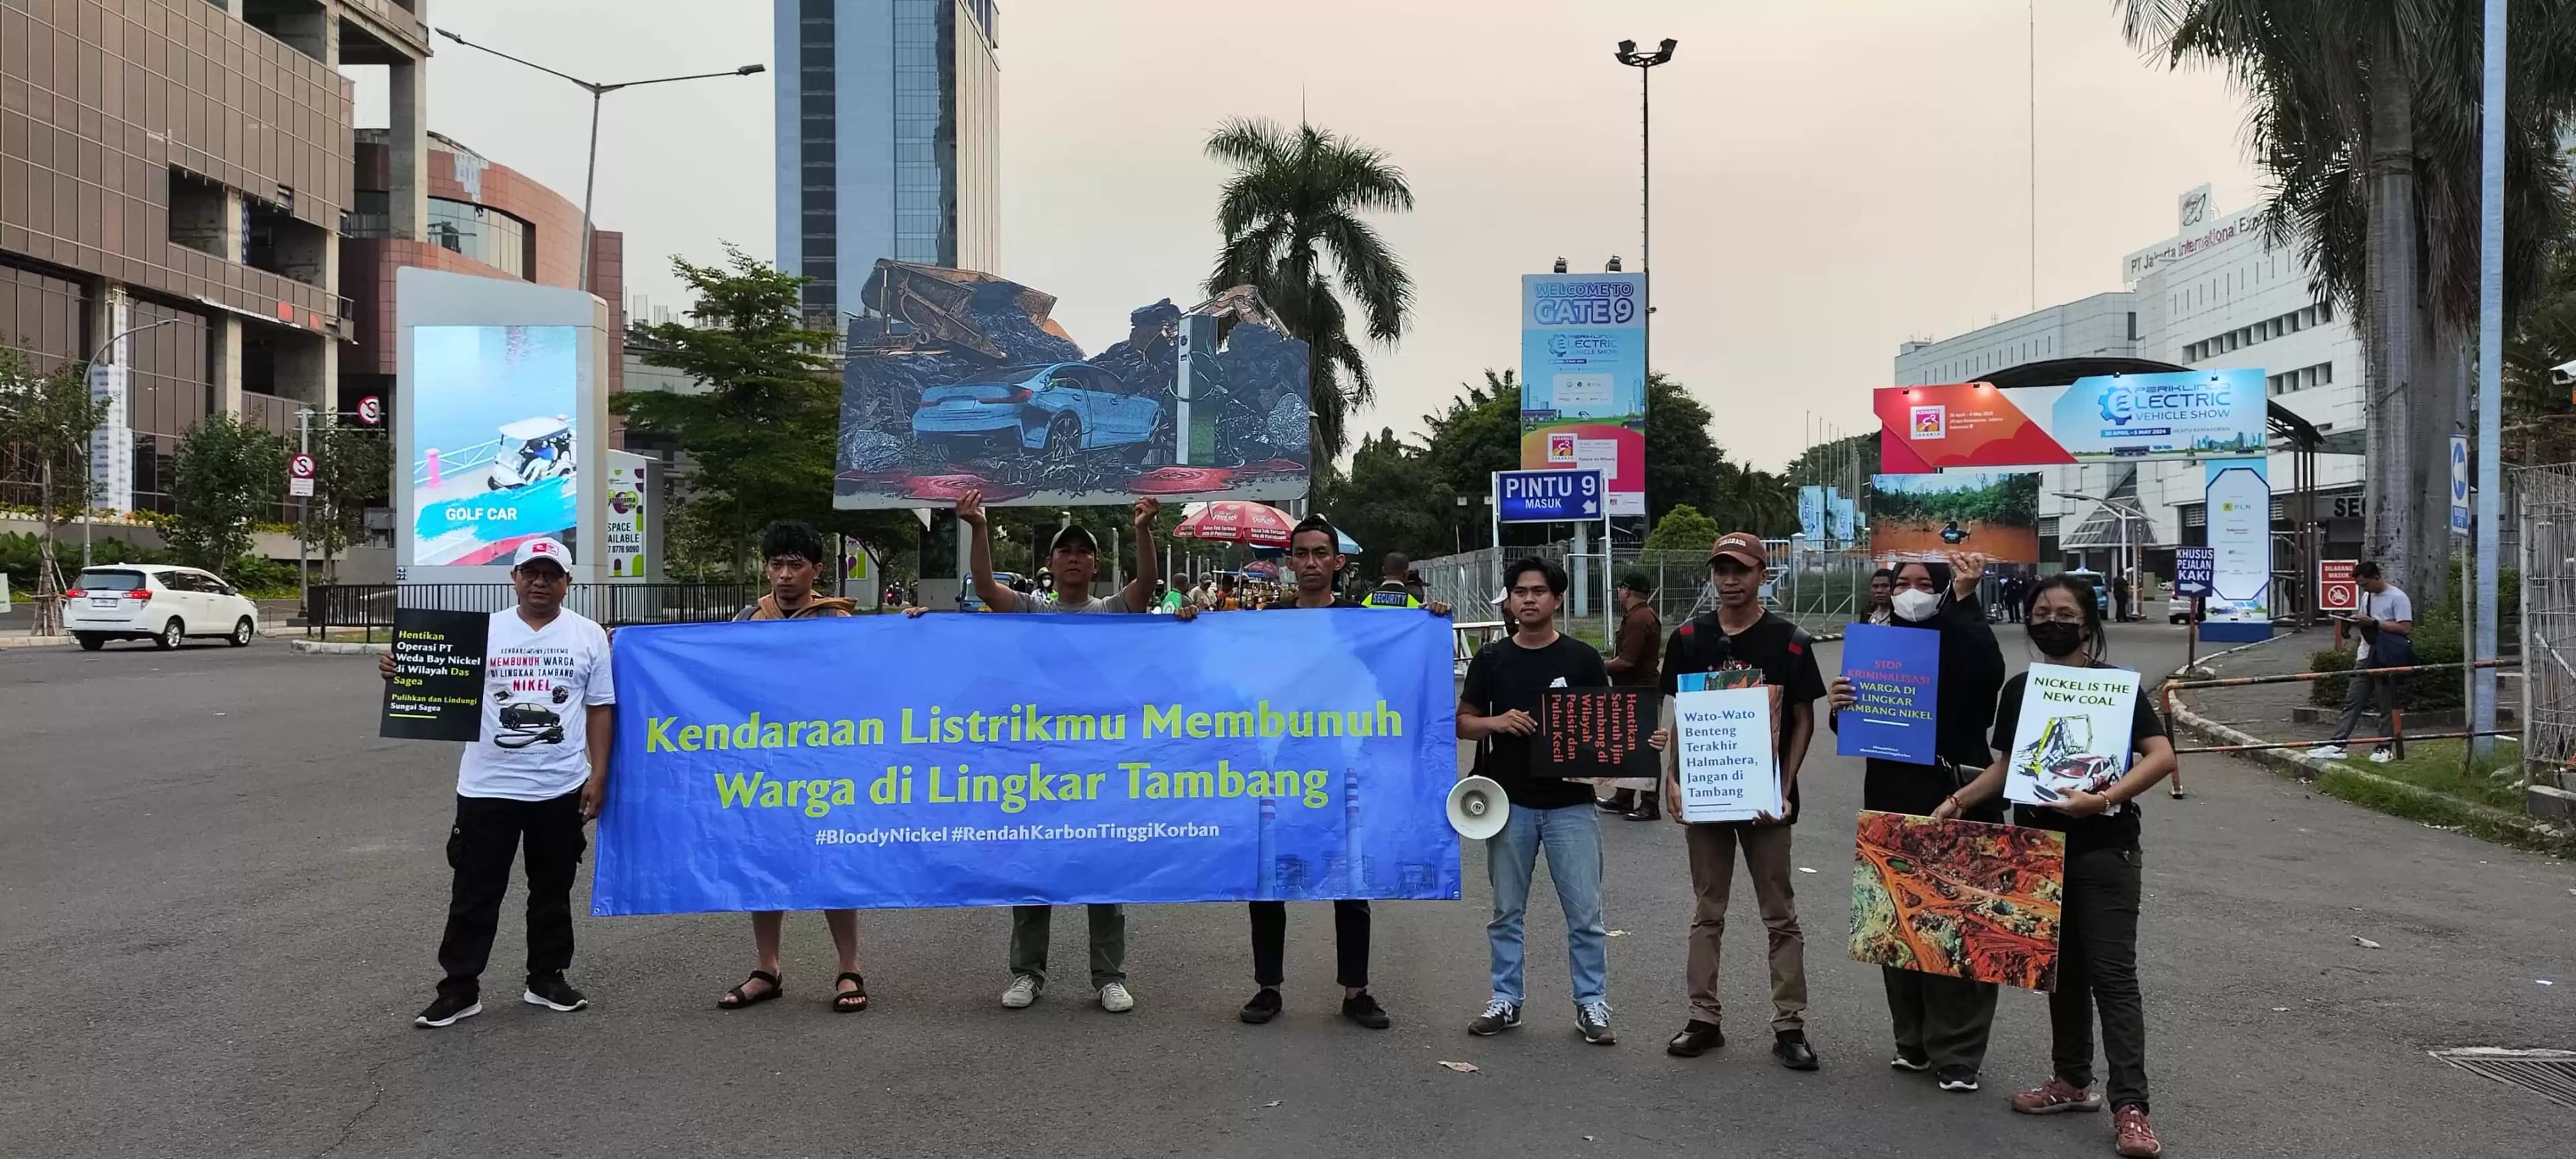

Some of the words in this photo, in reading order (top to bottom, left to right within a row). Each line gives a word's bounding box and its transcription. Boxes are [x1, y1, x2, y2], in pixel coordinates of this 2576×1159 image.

[2131, 257, 2142, 274] PT
[2178, 220, 2237, 257] International
[1534, 283, 1610, 298] WELCOME
[1611, 281, 1634, 297] TO
[1534, 298, 1611, 325] GATE
[1614, 297, 1634, 324] 9
[2135, 383, 2231, 393] PERIKLINDO
[2135, 411, 2188, 421] VEHICLE
[2190, 409, 2231, 419] SHOW
[1506, 476, 1572, 498] PINTU
[1581, 475, 1595, 497] 9
[1525, 499, 1562, 509] MASUK
[2334, 498, 2365, 517] SE
[445, 507, 484, 521] GOLF
[487, 507, 518, 521] CAR
[608, 523, 631, 532] SPACE
[608, 534, 639, 543] AILABLE
[2176, 548, 2214, 559] KHUSUS
[2177, 559, 2212, 570] PEJALAN
[2178, 570, 2210, 581] KAKI
[1373, 593, 1407, 605] SECURITY
[398, 630, 444, 640] Hentikan
[396, 642, 436, 652] Operasi
[439, 644, 453, 652] PT
[396, 653, 424, 662] Weda
[427, 654, 445, 665] Bay
[448, 656, 480, 665] Nickel
[490, 657, 540, 666] MEMBUNUH
[543, 657, 574, 666] WARGA
[1874, 660, 1902, 669] STOP
[396, 664, 405, 673] di
[407, 665, 447, 676] Wilayah
[451, 668, 470, 676] Das
[490, 669, 498, 677] DI
[500, 668, 534, 677] LINGKAR
[538, 668, 574, 677] TAMBANG
[393, 676, 423, 687] Sagea
[1847, 669, 1930, 684] KRIMINALISASI
[513, 679, 551, 691] NIKEL
[1860, 682, 1900, 693] WARGA
[1904, 686, 1916, 695] DI
[2035, 676, 2084, 691] NICKEL
[2088, 683, 2100, 691] IS
[2103, 683, 2131, 694] THE
[392, 694, 426, 702] Pulihkan
[444, 697, 477, 705] Lindungi
[1862, 694, 1913, 706] LINGKAR
[2043, 691, 2076, 703] NEW
[2078, 695, 2115, 706] COAL
[390, 703, 417, 711] Sungai
[419, 704, 441, 712] Sagea
[1551, 694, 1562, 727] Pulau
[1566, 694, 1576, 734] Pesisir
[1580, 694, 1593, 742] Wilayah
[1611, 693, 1623, 741] Seluruh
[1684, 710, 1756, 722] Wato-Wato
[1899, 709, 1933, 720] NIKEL
[645, 711, 884, 753] Kendaraan
[901, 704, 1126, 745] Listrikmu
[1142, 699, 1403, 740] Membunuh
[1595, 693, 1607, 748] Tambang
[1626, 693, 1638, 750] Hentikan
[1685, 727, 1737, 738] Benteng
[1553, 732, 1564, 762] Kecil
[1568, 738, 1578, 760] dan
[1685, 740, 1738, 752] Terakhir
[1598, 752, 1609, 762] di
[1610, 745, 1623, 764] Ijin
[1686, 756, 1758, 767] Halmahera,
[1687, 772, 1728, 784] Jangan
[1732, 770, 1743, 780] di
[714, 771, 856, 818] Warga
[869, 765, 912, 805] di
[928, 762, 1106, 814] Lingkar
[1118, 758, 1330, 809] Tambang
[1688, 787, 1744, 799] Tambang
[815, 826, 947, 847] #BloodyNickel
[951, 823, 1220, 843] #RendahKarbonTinggiKorban
